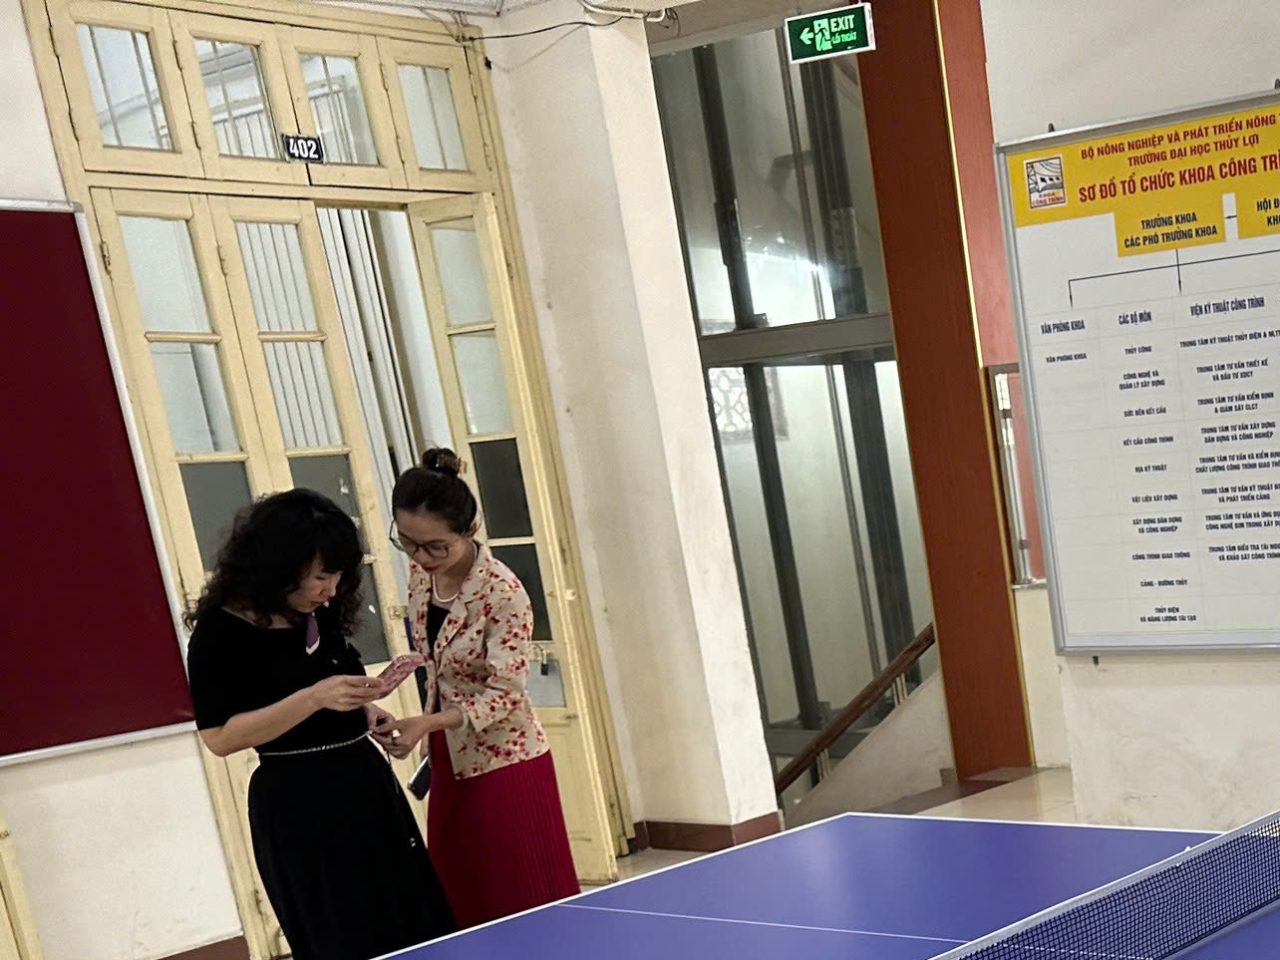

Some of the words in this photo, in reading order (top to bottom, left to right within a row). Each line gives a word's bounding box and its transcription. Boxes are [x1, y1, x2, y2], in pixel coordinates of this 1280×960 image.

[830, 14, 855, 33] EXIT
[1081, 146, 1094, 160] BỘ
[1097, 142, 1125, 157] NÔNG
[1128, 134, 1164, 152] NGHIỆP
[1167, 130, 1181, 144] VÀ
[1183, 126, 1209, 141] PHÁT
[1212, 117, 1243, 137] TRIỂN
[1246, 114, 1276, 130] NÔNG
[289, 138, 319, 159] 402
[1128, 151, 1167, 167] TRƯỜNG
[1170, 147, 1187, 160] ĐẠI
[1190, 143, 1211, 157] HỌC
[1213, 137, 1240, 152] THỦY
[1243, 134, 1259, 148] LỢI
[1079, 184, 1096, 203] SƠ
[1099, 176, 1117, 199] ĐỒ
[1120, 172, 1136, 196] TỔ
[1140, 168, 1175, 192] CHỨC
[1179, 164, 1215, 186] KHOA
[1219, 157, 1257, 179] CÔNG
[1257, 198, 1271, 213] HỘI
[1141, 216, 1173, 230] TRƯỞNG
[1175, 212, 1197, 225] KHOA
[1124, 236, 1141, 248] CÁC
[1142, 232, 1159, 246] PHÓ
[1161, 228, 1193, 243] TRƯỞNG
[1195, 225, 1218, 238] KHOA
